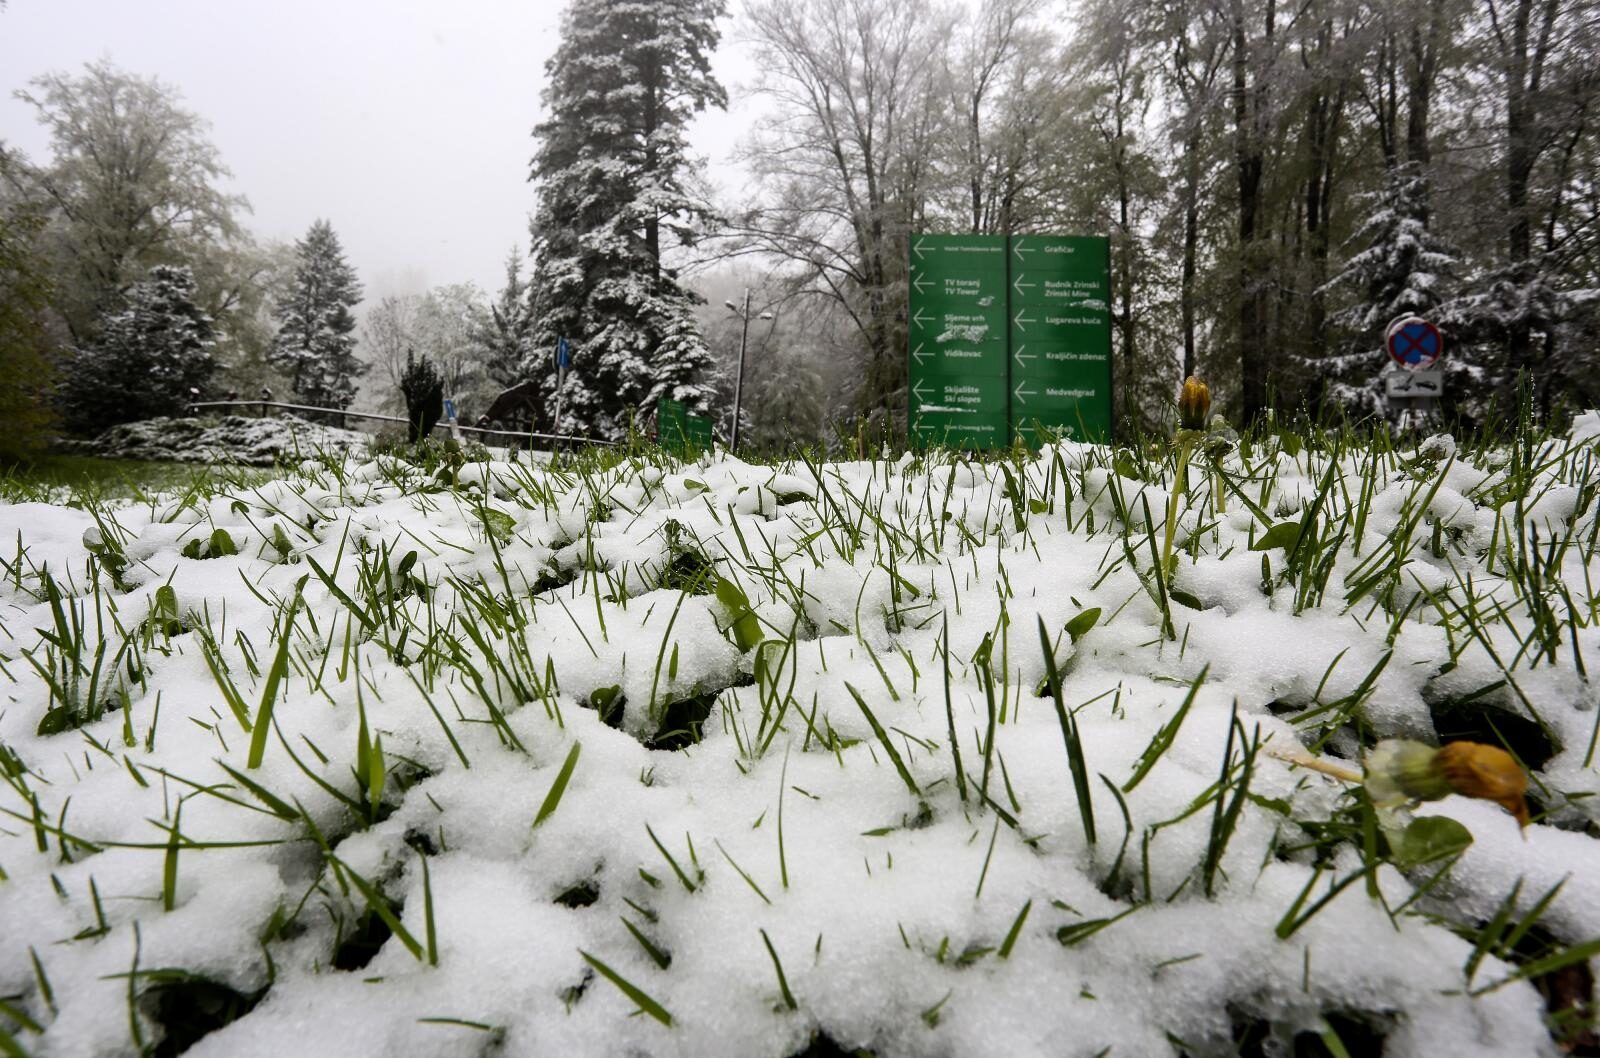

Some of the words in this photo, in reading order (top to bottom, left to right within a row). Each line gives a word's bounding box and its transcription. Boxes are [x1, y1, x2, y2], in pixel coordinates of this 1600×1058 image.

[956, 279, 980, 288] toranj
[1073, 281, 1100, 289] Zrinski
[945, 314, 970, 322] Sljeme
[1046, 316, 1080, 325] Lugareva
[944, 349, 982, 357] Vidikovac
[1079, 352, 1106, 360] zdenac
[1046, 388, 1095, 398] Medvedgrad
[957, 395, 981, 404] slopes
